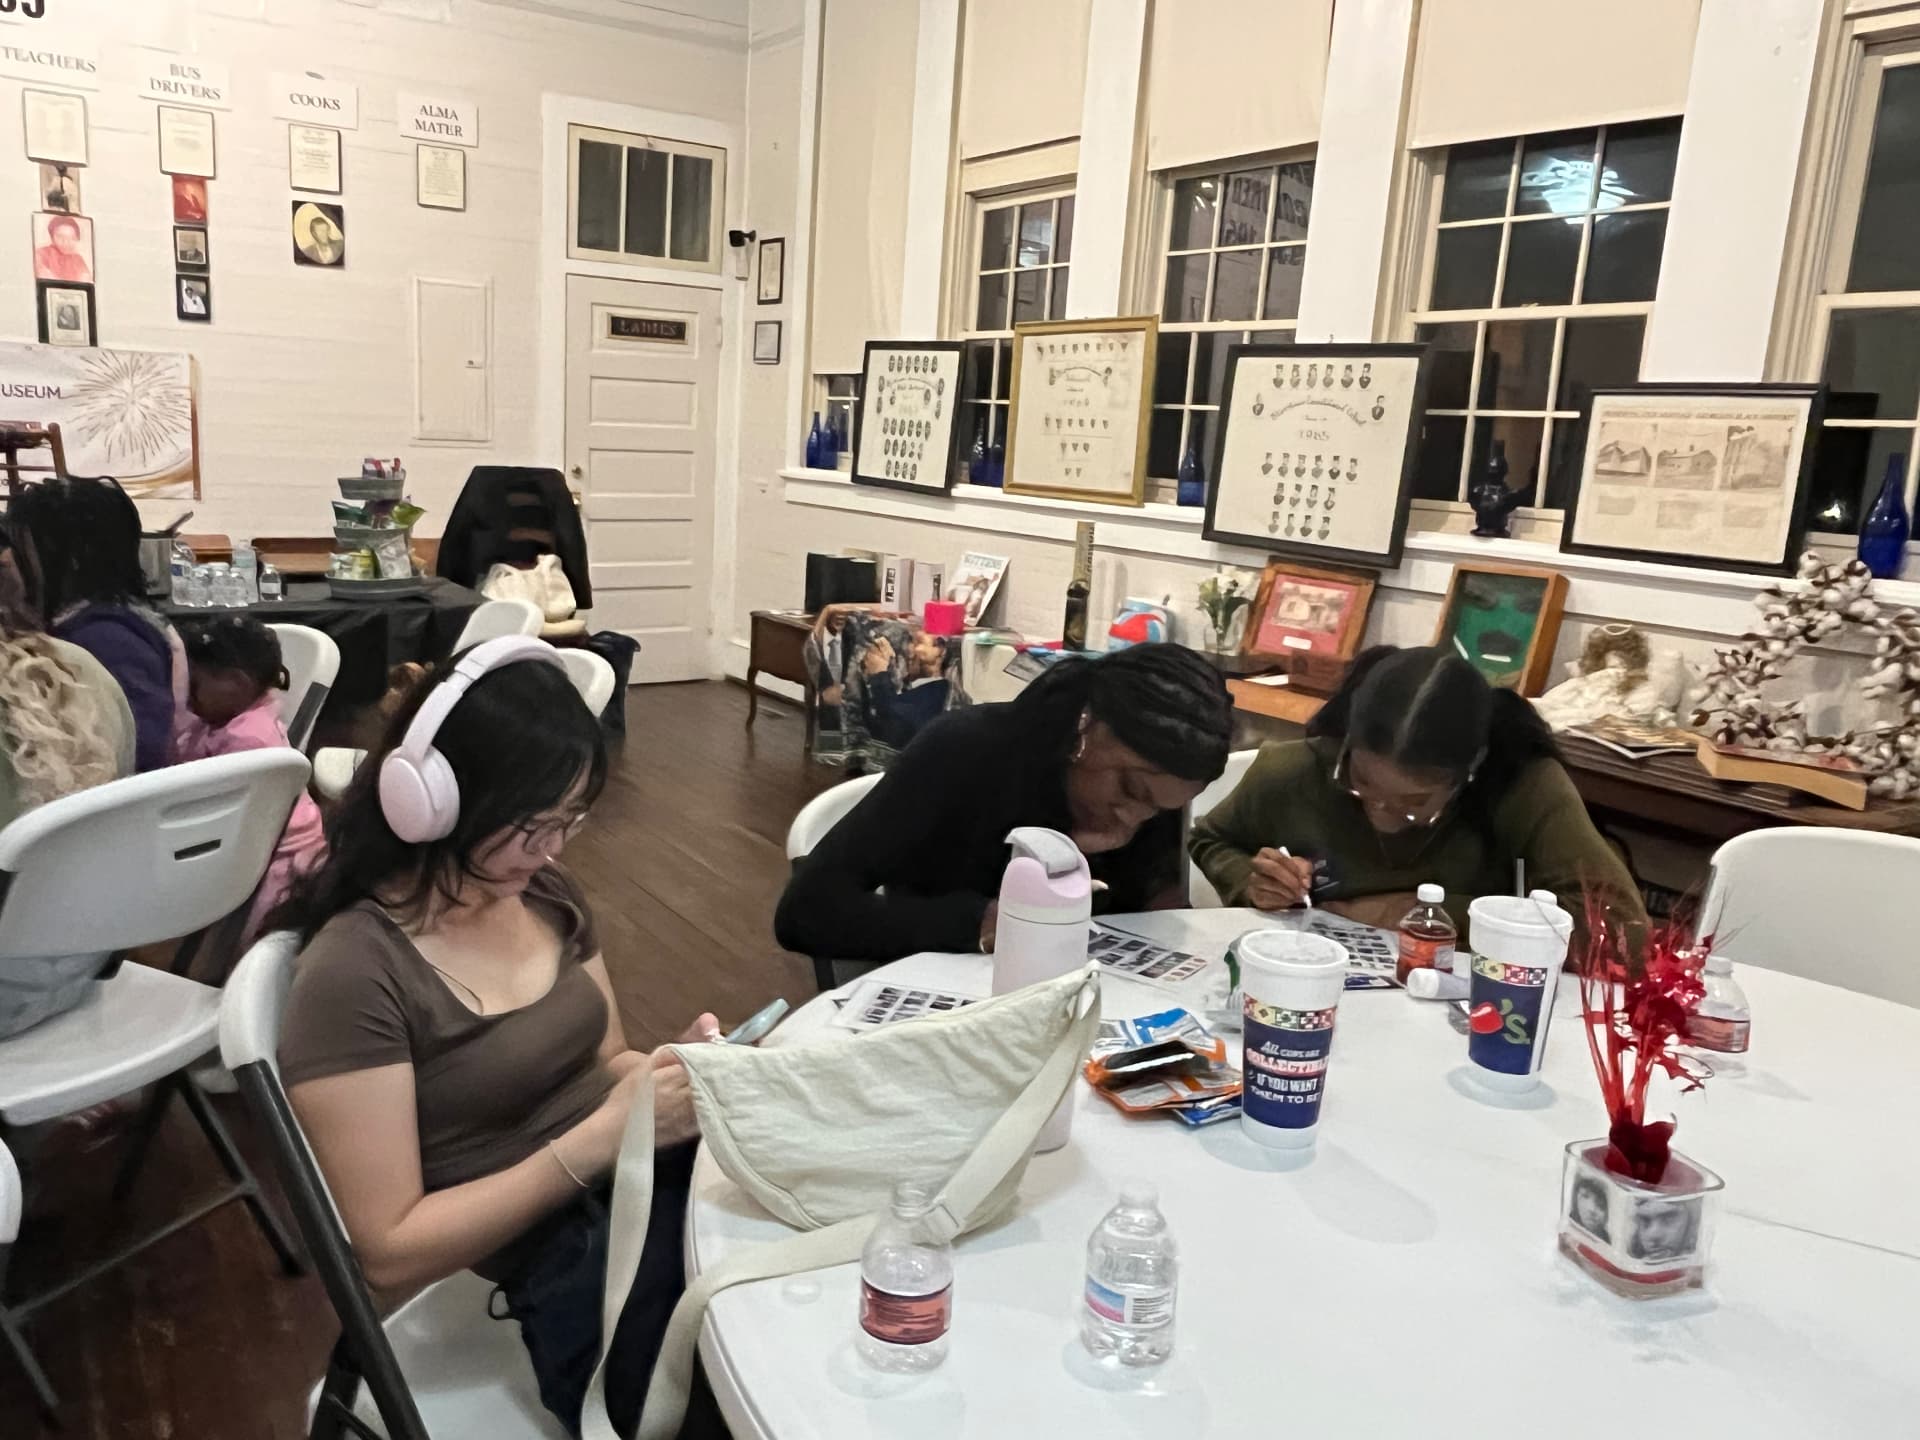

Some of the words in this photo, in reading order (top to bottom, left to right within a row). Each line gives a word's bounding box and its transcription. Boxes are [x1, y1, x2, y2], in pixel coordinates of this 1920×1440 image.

[2, 46, 97, 73] TEACHERS
[169, 63, 201, 80] BUS
[149, 77, 221, 100] DRIVERS
[289, 92, 342, 112] COOKS
[419, 103, 460, 122] ALMA
[414, 118, 464, 138] MATER
[1, 383, 62, 400] USEUM
[1267, 1075, 1289, 1092] YOU
[1289, 1078, 1318, 1093] WANT
[1286, 1094, 1304, 1104] TO
